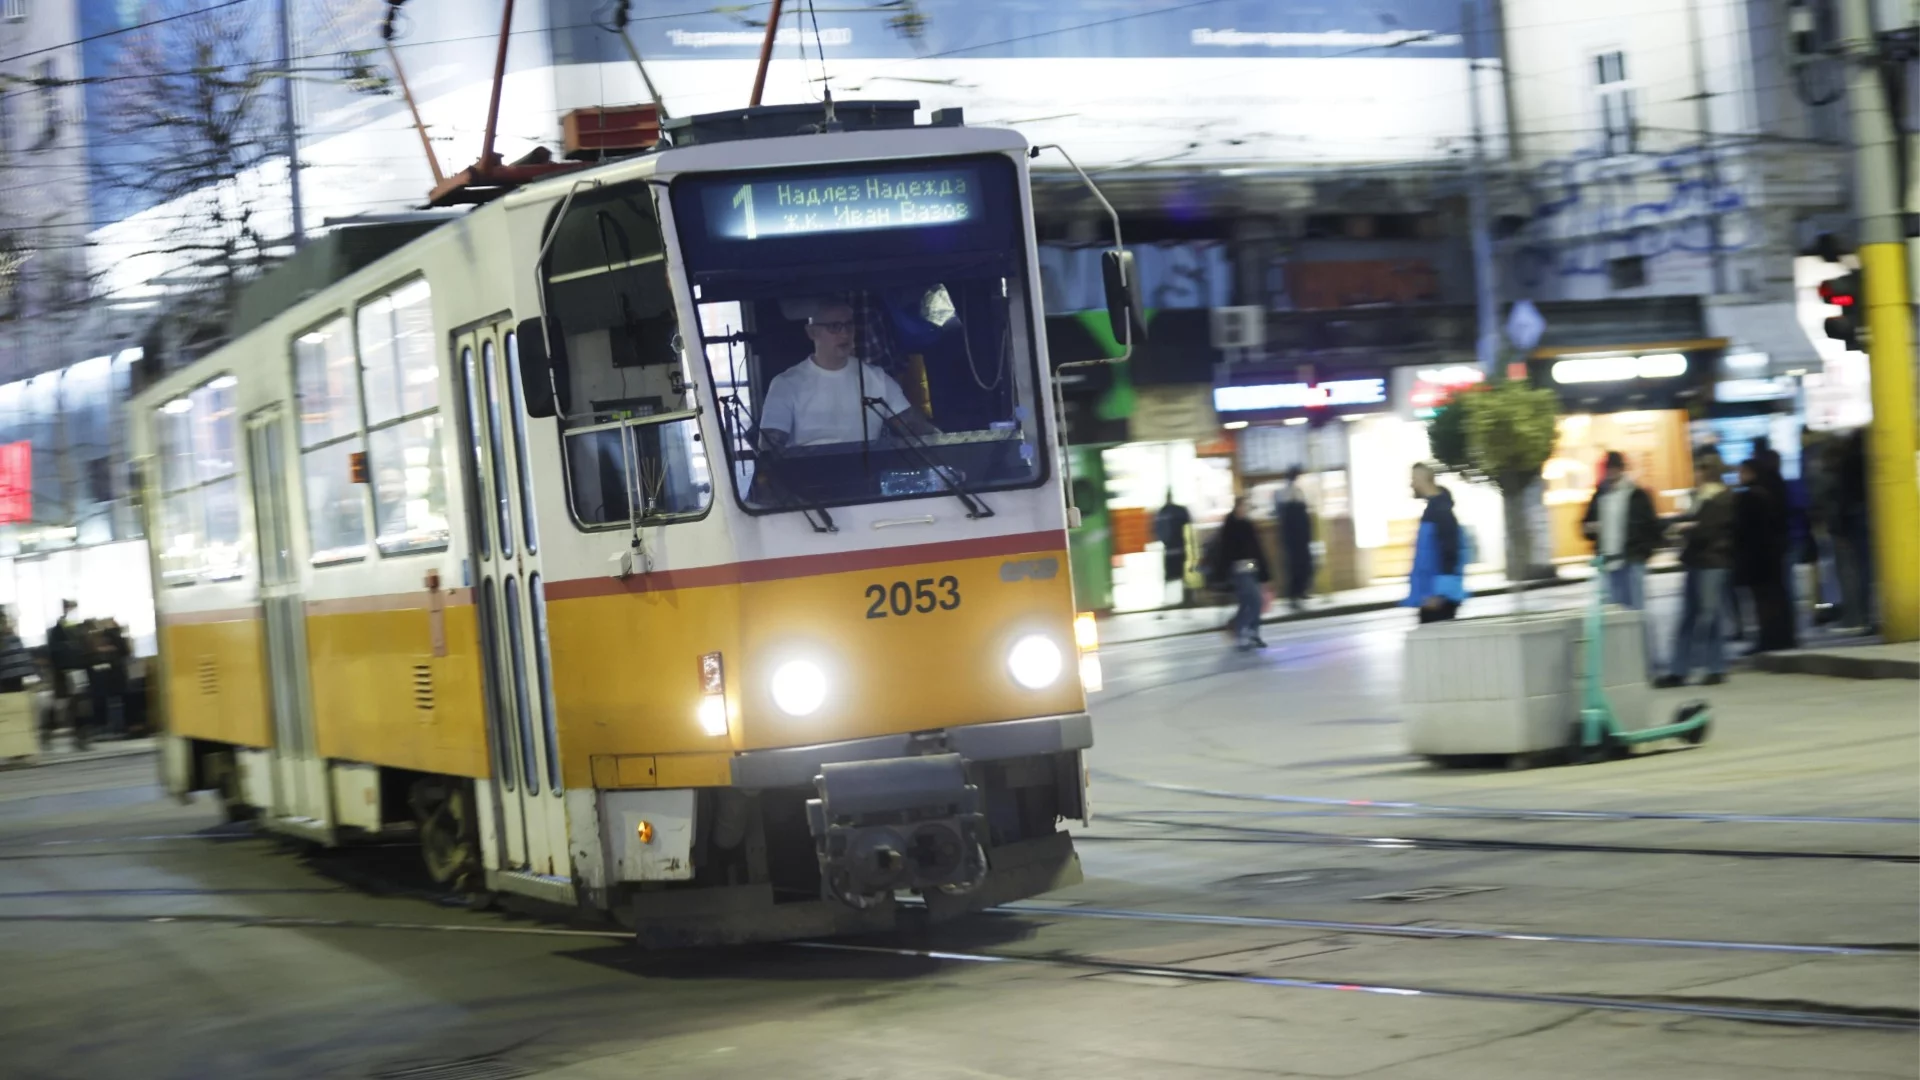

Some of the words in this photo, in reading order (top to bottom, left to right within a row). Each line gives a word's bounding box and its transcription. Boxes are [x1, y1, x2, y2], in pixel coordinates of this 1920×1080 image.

[778, 185, 861, 206] Надлез
[866, 177, 967, 201] Надежда
[732, 184, 757, 239] 1
[834, 205, 890, 227] Иван
[900, 200, 969, 222] Вазов
[865, 575, 961, 619] 2053
